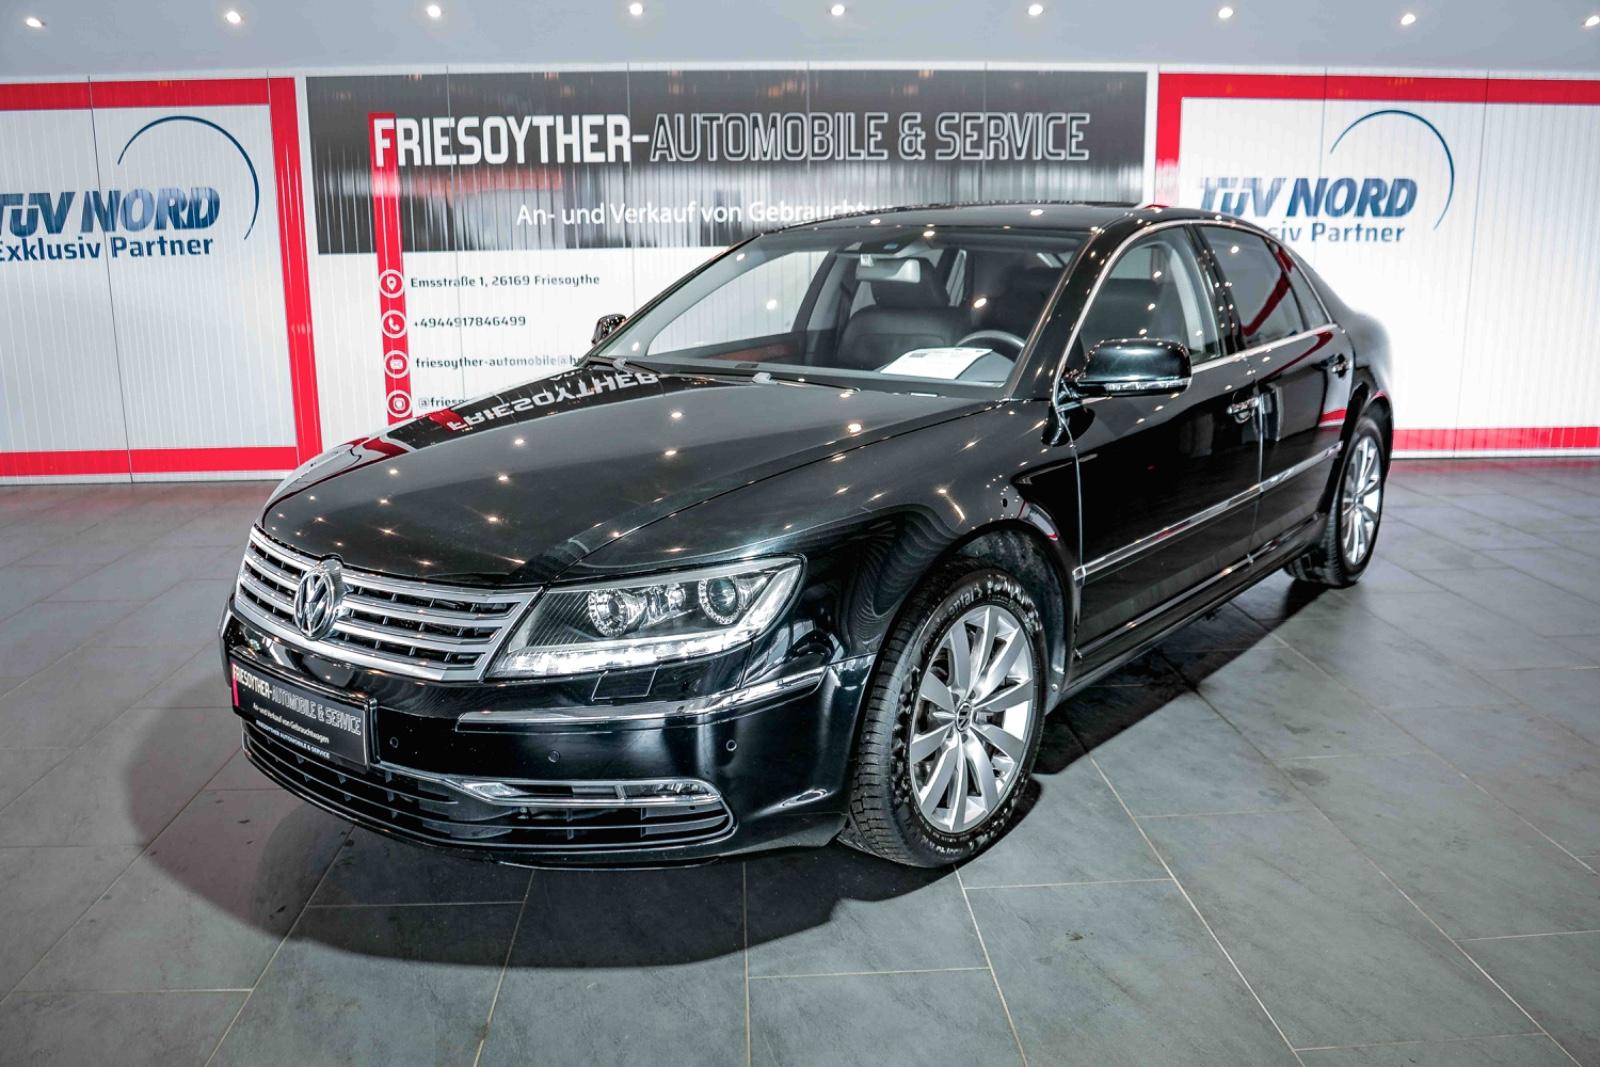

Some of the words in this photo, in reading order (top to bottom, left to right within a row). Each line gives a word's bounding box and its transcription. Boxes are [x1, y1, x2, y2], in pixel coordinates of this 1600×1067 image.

[374, 112, 889, 167] FRIESOYTHER-AUTOMOBILE
[898, 112, 926, 161] &
[935, 112, 1090, 161] SERVICE
[81, 186, 220, 233] NORD
[1286, 177, 1418, 217] NORD
[516, 204, 555, 225] An-
[562, 202, 604, 225] und
[610, 201, 697, 224] Verkauf
[702, 206, 742, 222] von
[1312, 222, 1405, 242] Partner
[112, 235, 213, 258] Partner
[410, 275, 476, 288] Emsstraße
[479, 276, 488, 288] 1,
[491, 275, 530, 286] 26169
[534, 274, 600, 288] Friesoythe
[325, 706, 361, 735] SERVICE
